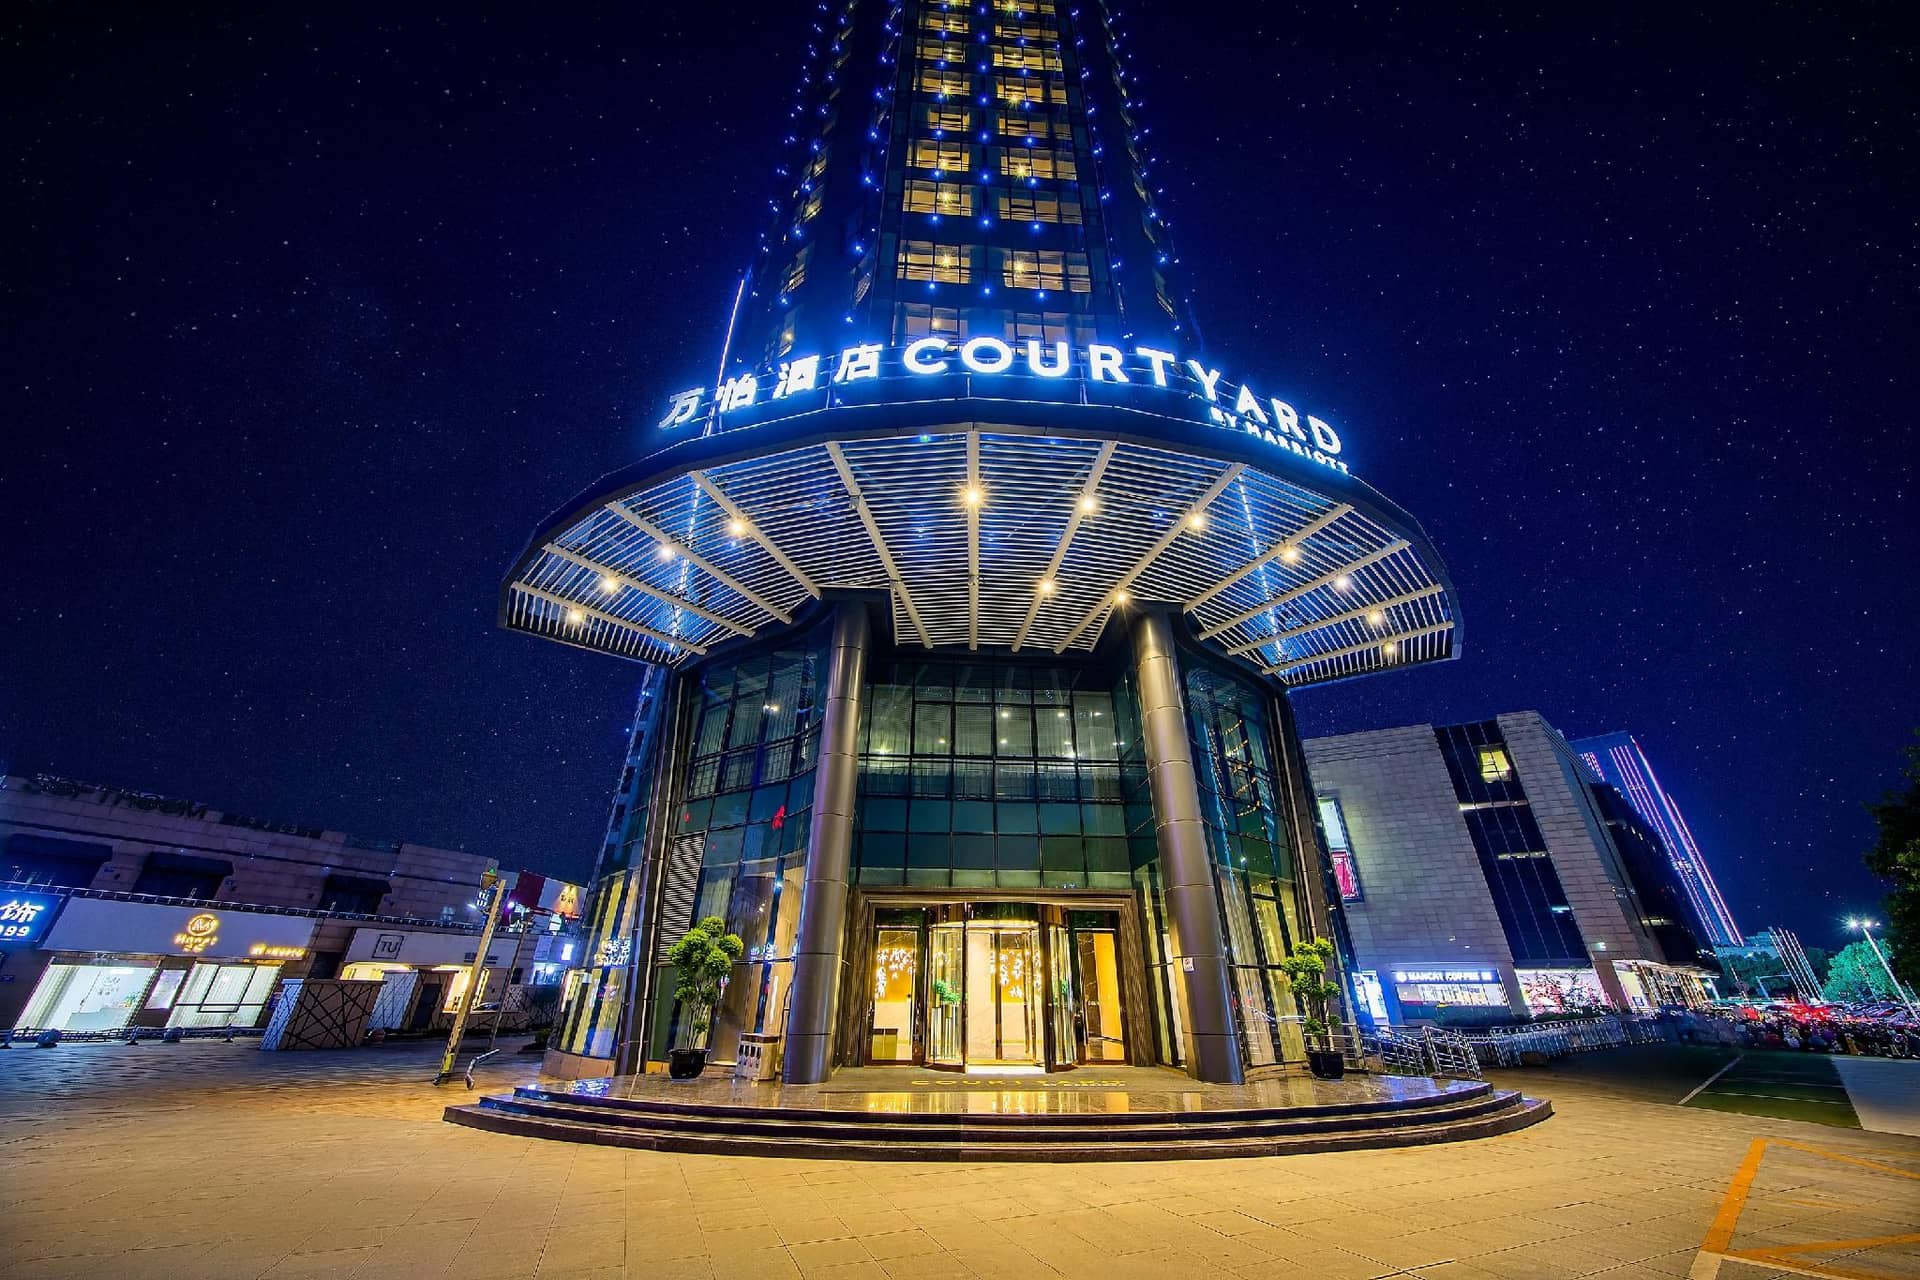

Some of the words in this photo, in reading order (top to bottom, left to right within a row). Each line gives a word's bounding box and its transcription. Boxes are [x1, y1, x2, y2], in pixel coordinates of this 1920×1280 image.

[658, 345, 883, 428] 万怡酒店
[903, 337, 1343, 455] COURTYARD
[1210, 406, 1238, 428] BY
[1244, 421, 1350, 475] MARRIOTT
